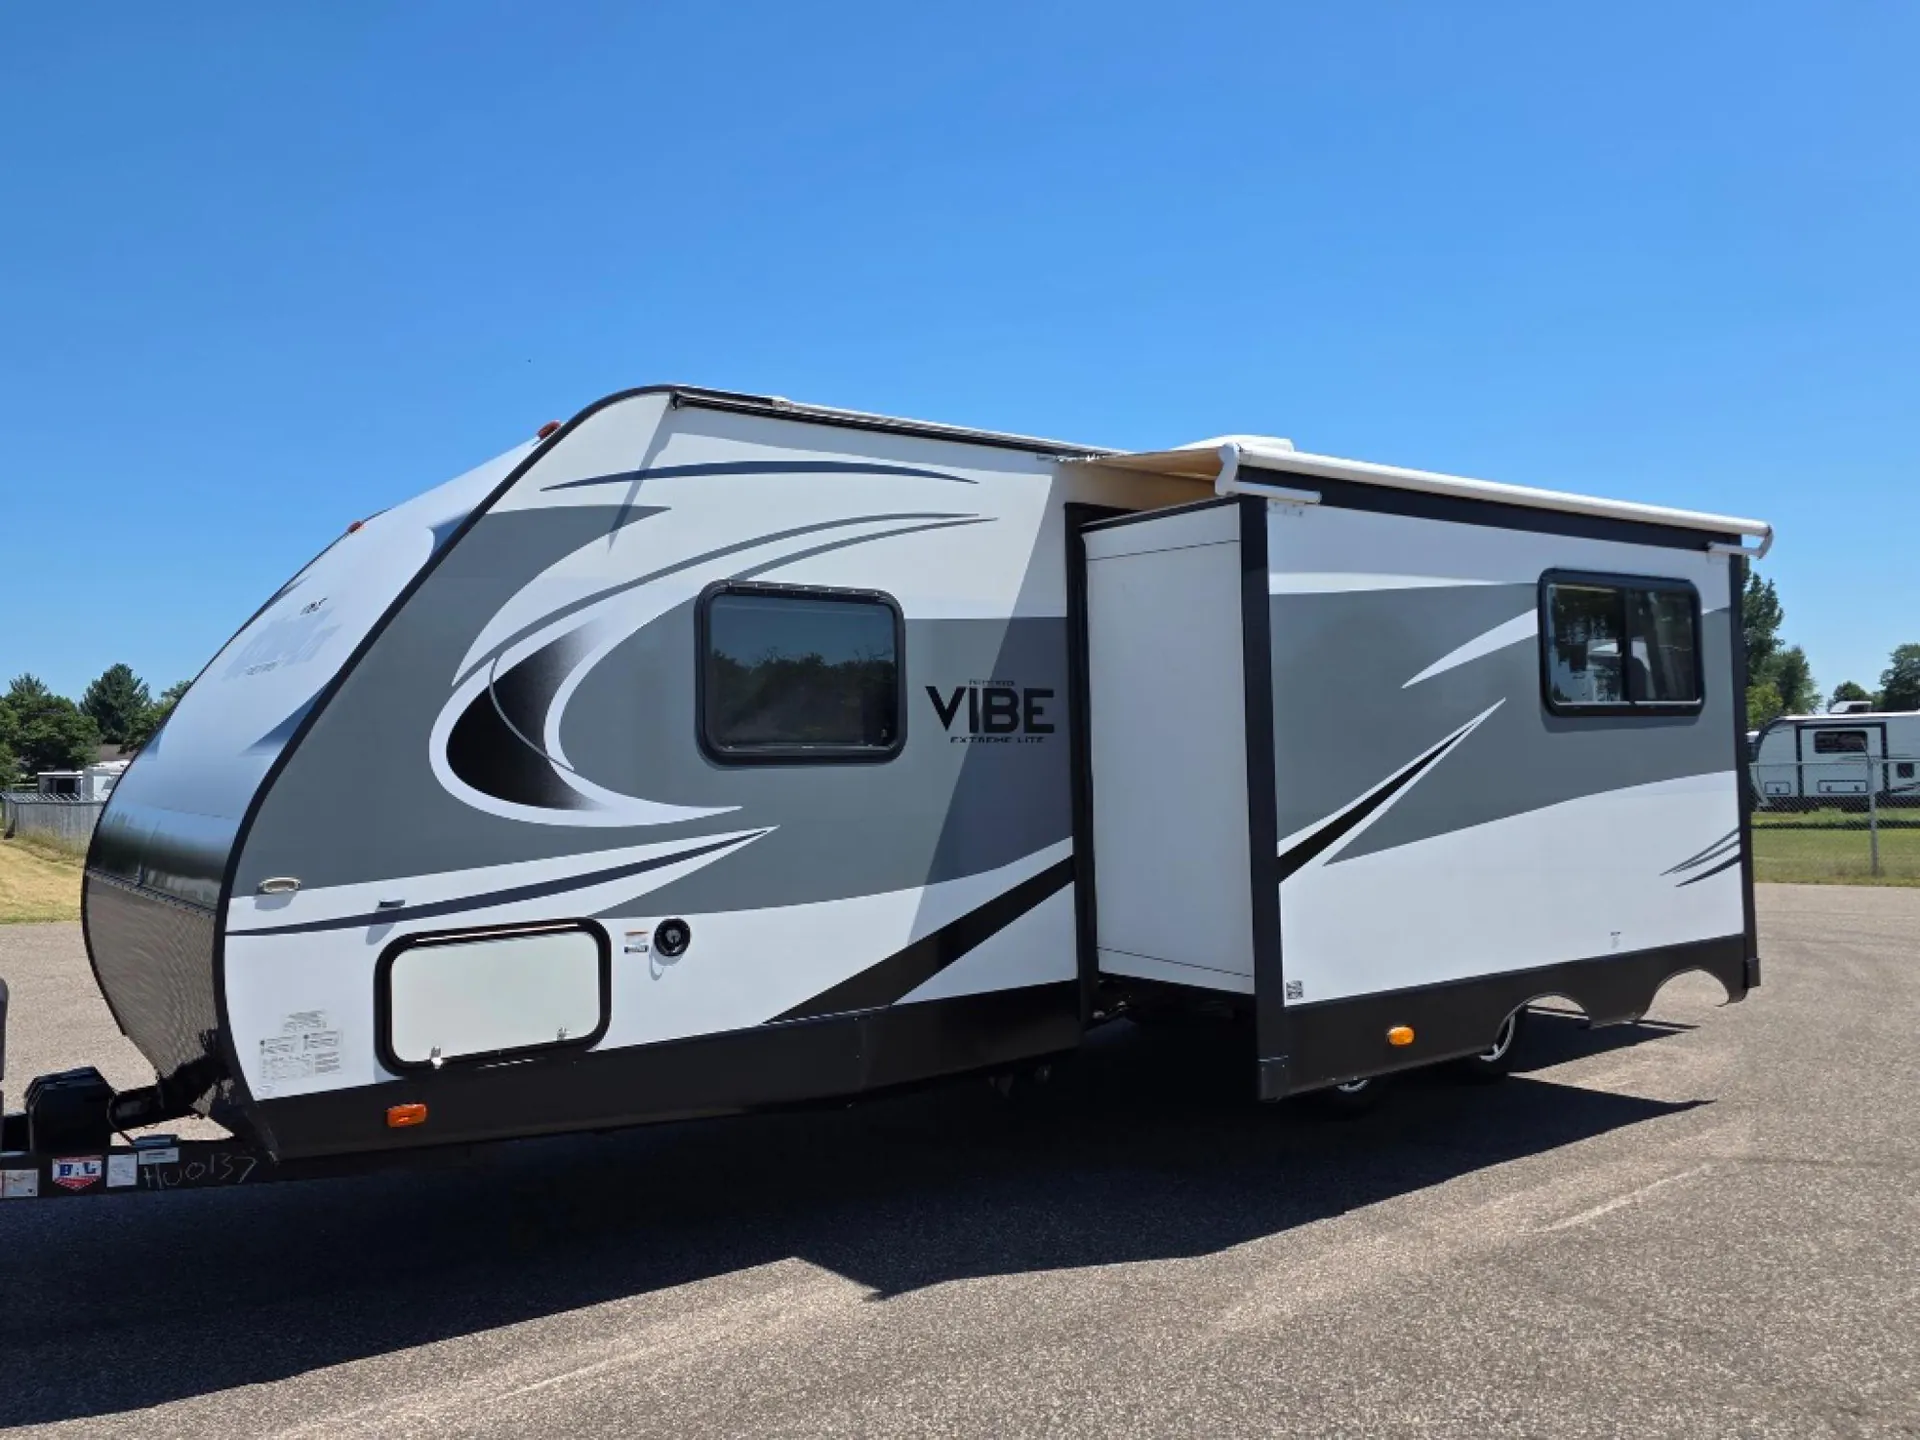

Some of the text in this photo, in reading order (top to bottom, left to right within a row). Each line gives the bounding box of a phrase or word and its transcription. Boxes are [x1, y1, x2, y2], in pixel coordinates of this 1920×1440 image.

[925, 686, 1055, 733] VIBE
[950, 736, 1045, 744] EXTREME LITE
